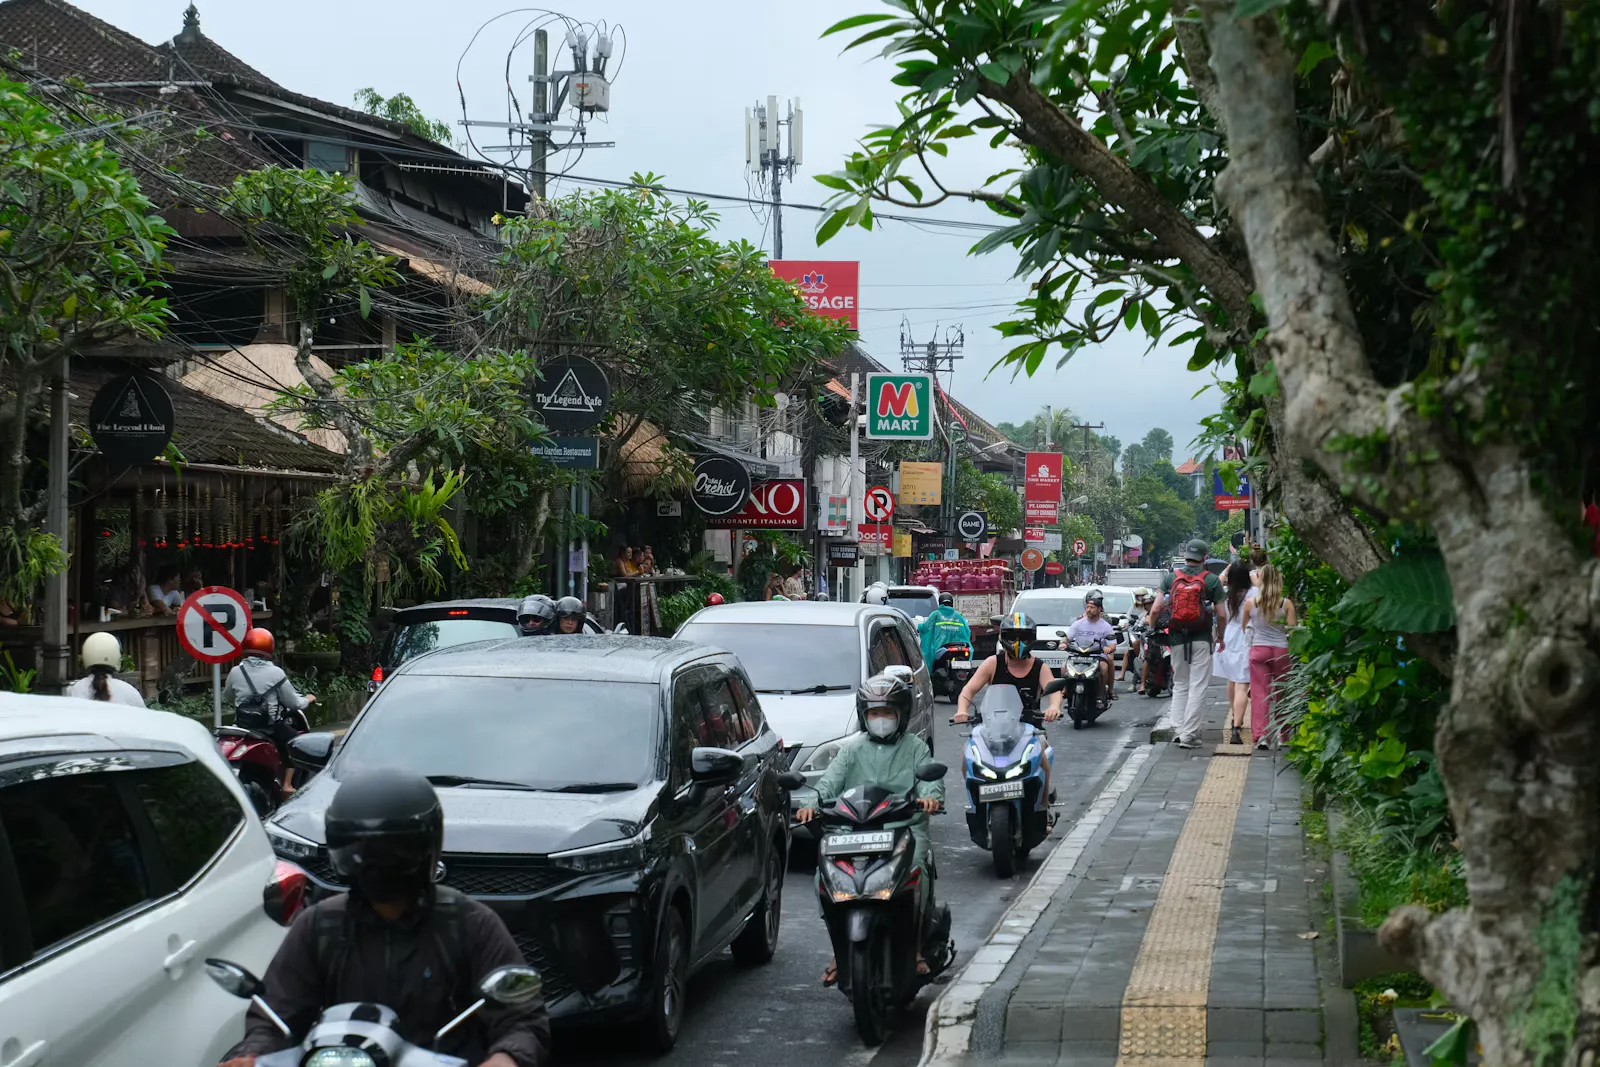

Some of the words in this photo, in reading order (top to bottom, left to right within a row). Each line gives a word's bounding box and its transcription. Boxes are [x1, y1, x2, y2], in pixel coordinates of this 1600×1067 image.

[536, 393, 551, 403] The
[553, 394, 583, 406] Legend
[584, 396, 603, 406] Cafe
[877, 419, 919, 431] MART
[544, 447, 562, 456] Garden
[563, 447, 592, 457] Restaurant
[694, 472, 737, 497] Orchid
[864, 532, 889, 540] OCC
